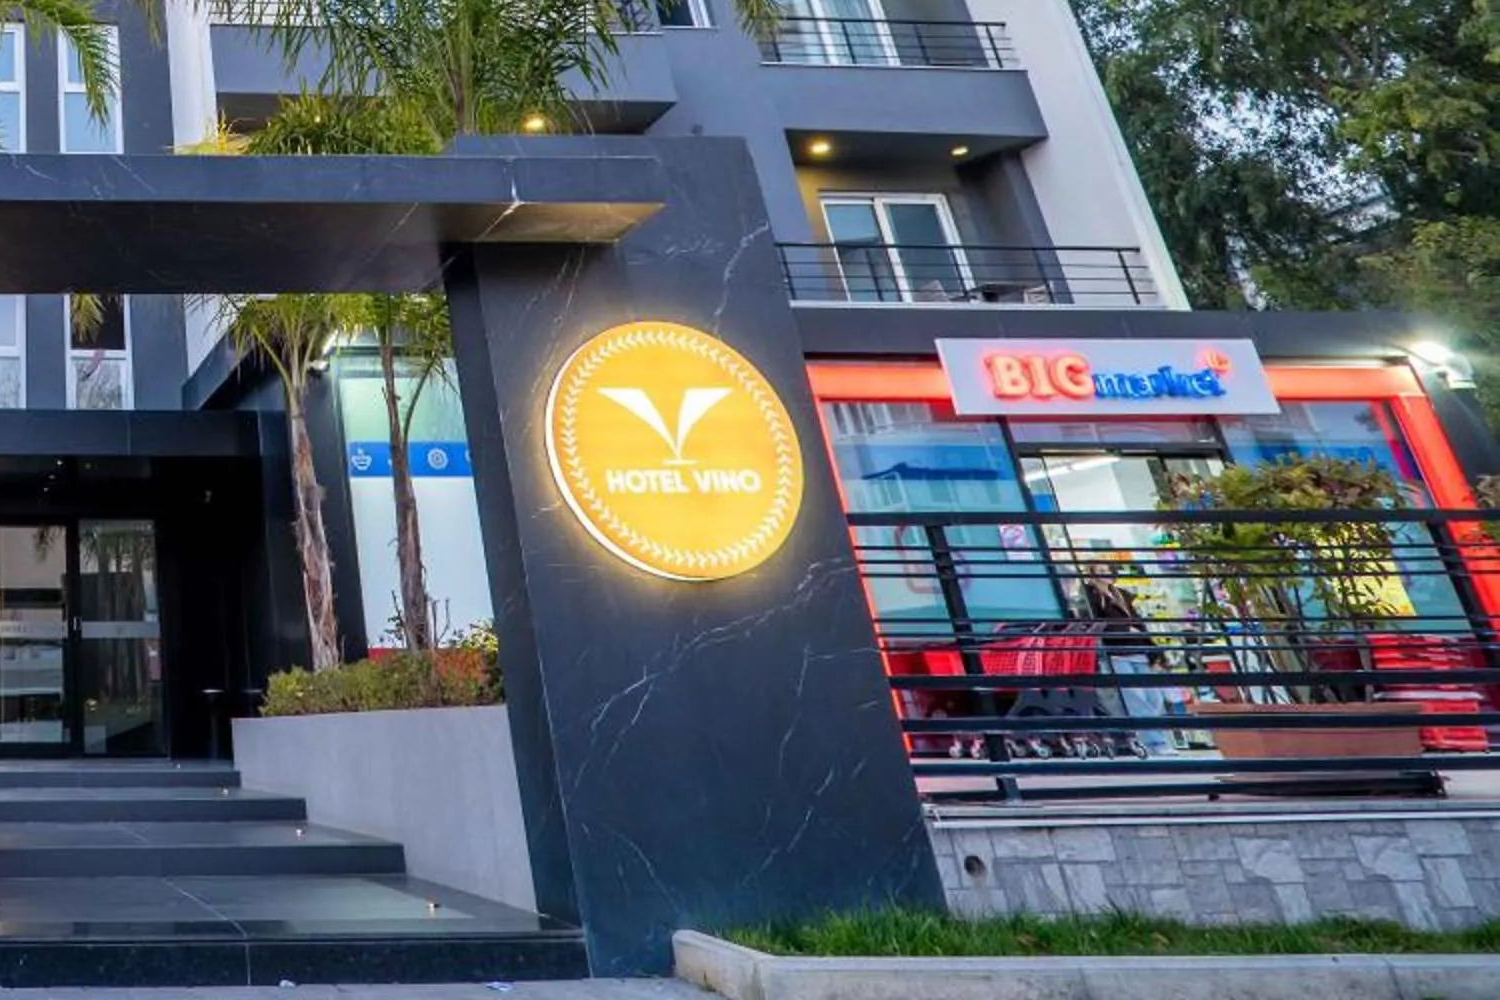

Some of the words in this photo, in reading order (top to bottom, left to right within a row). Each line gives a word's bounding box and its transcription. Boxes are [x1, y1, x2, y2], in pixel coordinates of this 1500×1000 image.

[984, 355, 1094, 400] BIG
[605, 468, 690, 494] HOTEL
[692, 468, 762, 494] VINO
